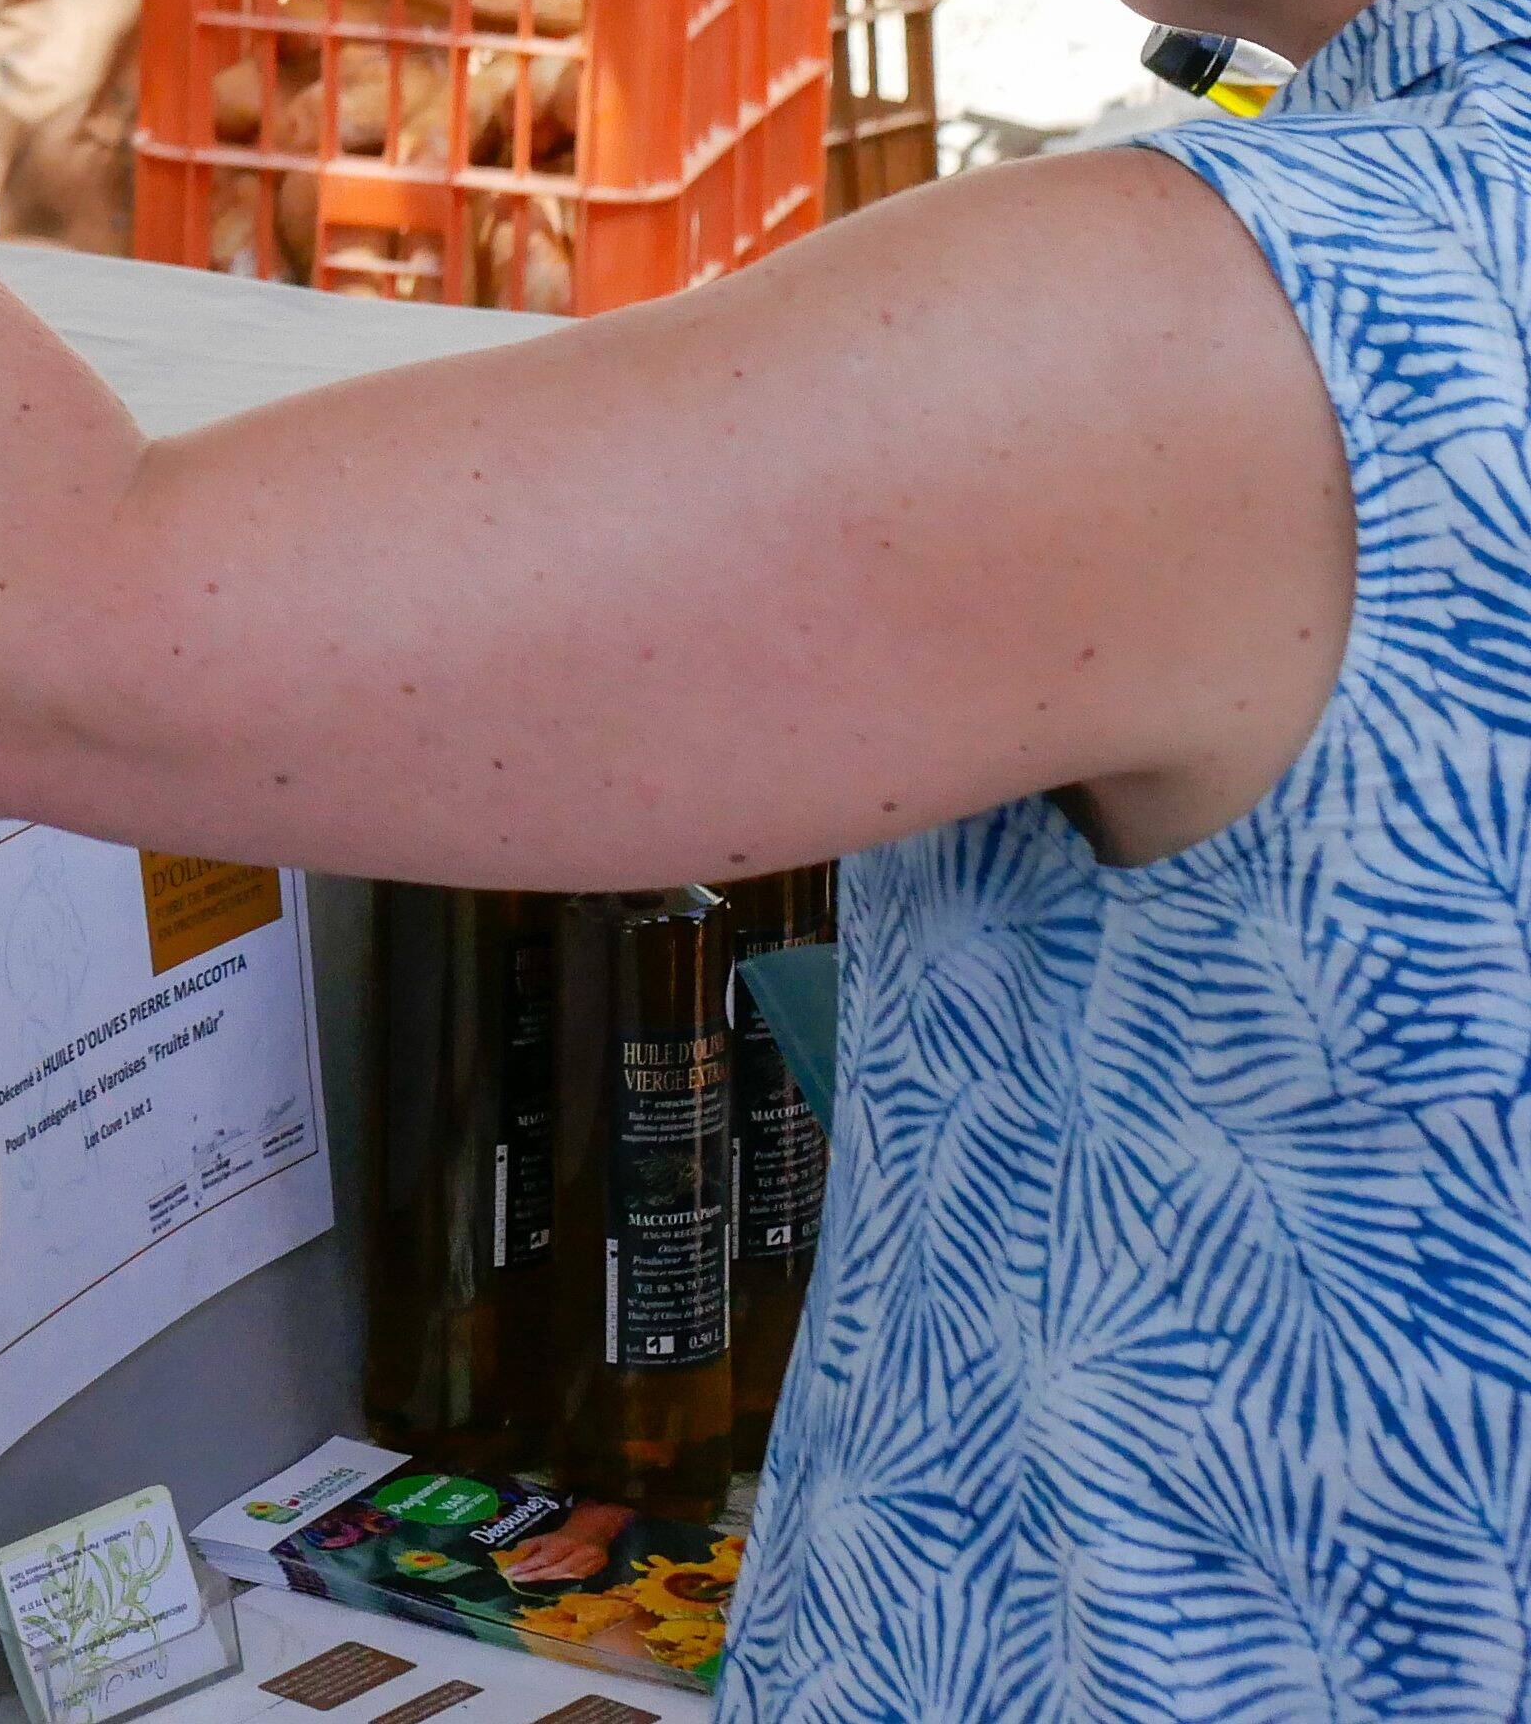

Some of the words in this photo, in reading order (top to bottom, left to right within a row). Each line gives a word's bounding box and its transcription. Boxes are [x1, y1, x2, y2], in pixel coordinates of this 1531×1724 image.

[36, 1066, 43, 1082] à
[42, 1043, 76, 1078] HUILE
[76, 1012, 128, 1057] D'OLIVES
[129, 989, 172, 1026] PIERRE
[173, 954, 248, 1002] MACCOTTA
[623, 1042, 674, 1066] HUILE
[623, 1069, 686, 1093] VIERGE
[4, 1132, 27, 1155] Pour
[27, 1124, 37, 1141] la
[37, 1098, 78, 1135] catégorie
[78, 1085, 98, 1107] Les
[97, 1055, 147, 1094] Varoises
[84, 1133, 100, 1150] Lot
[101, 1117, 123, 1140] Cuve
[628, 1210, 700, 1227] MACCOTTA
